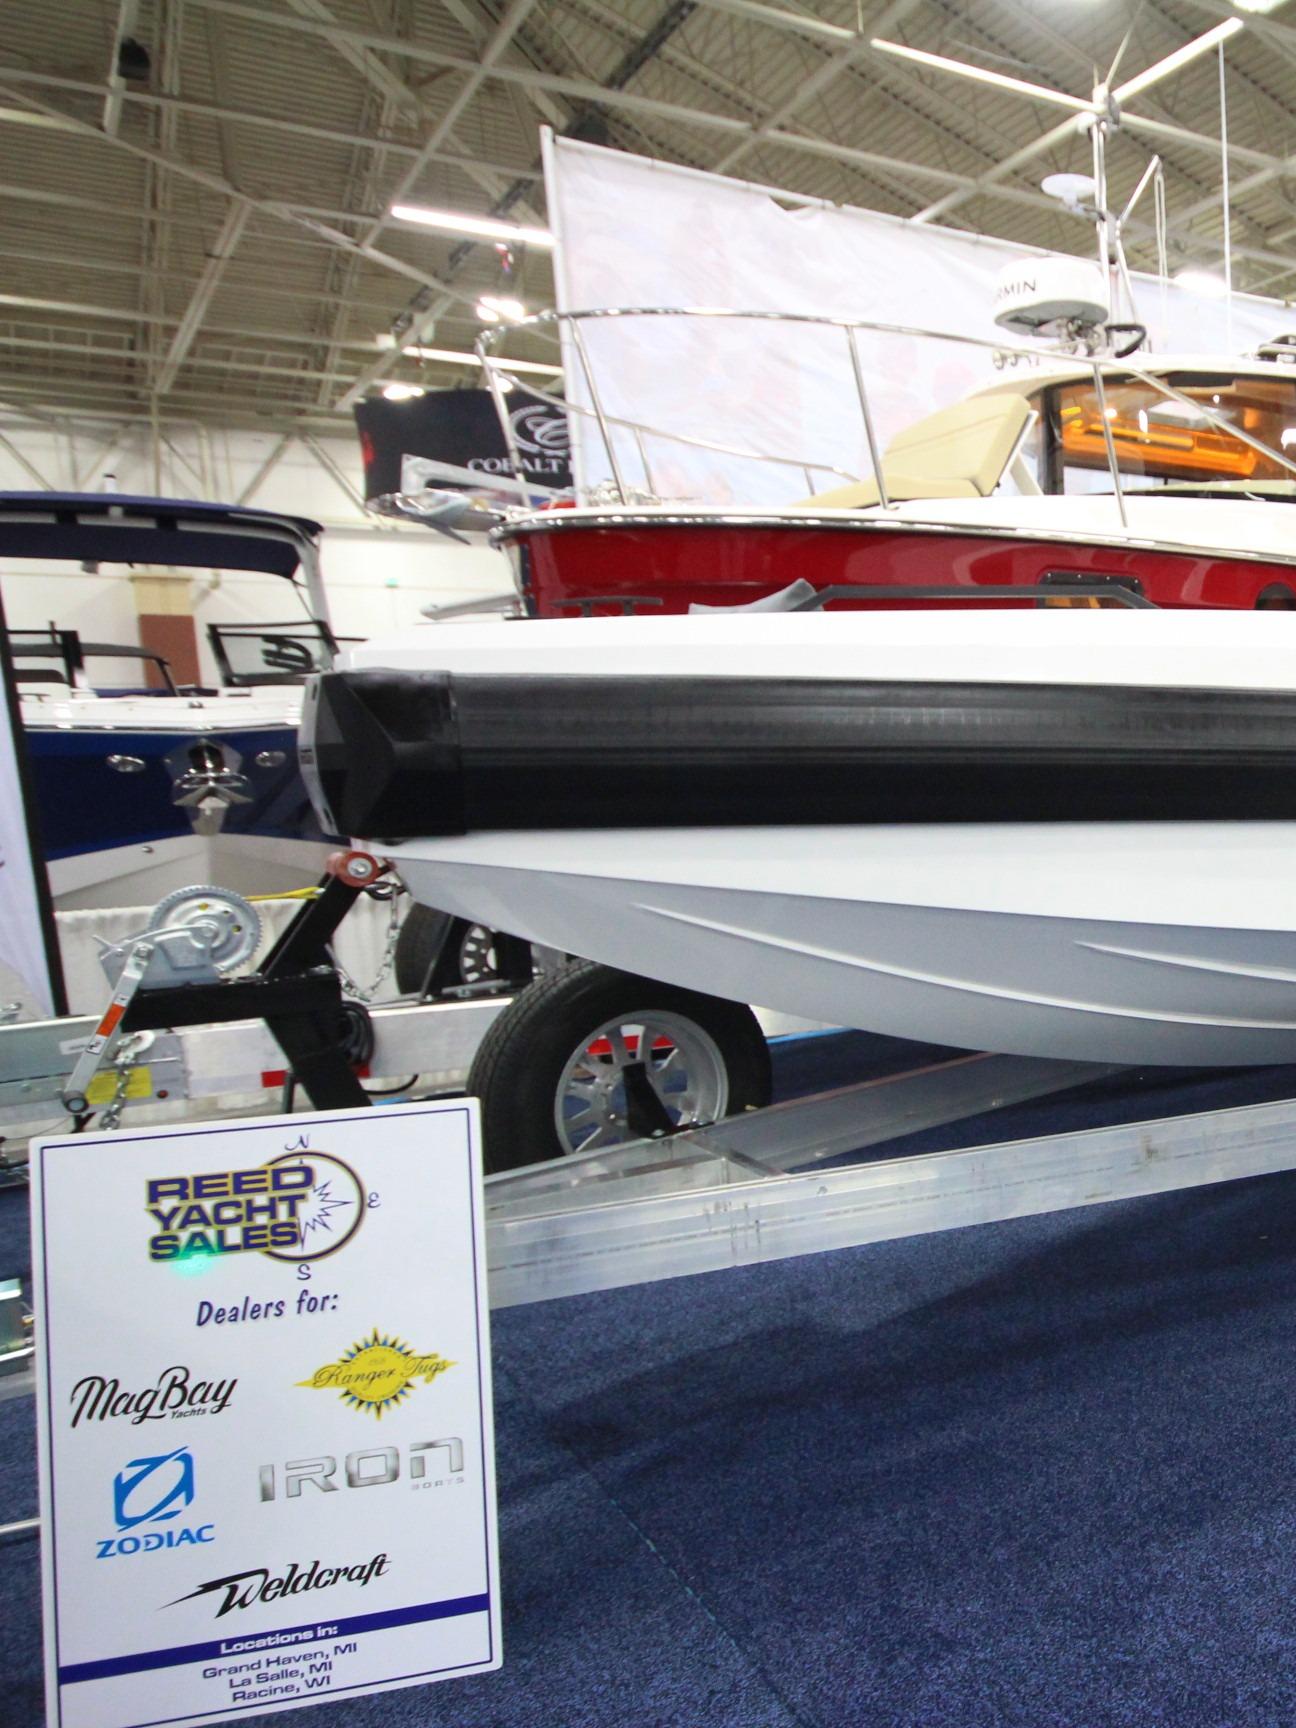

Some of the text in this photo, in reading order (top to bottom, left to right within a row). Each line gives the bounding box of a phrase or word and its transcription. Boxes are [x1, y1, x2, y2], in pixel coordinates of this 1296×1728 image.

[148, 1165, 315, 1204] REED
[149, 1193, 307, 1232] YACHT
[150, 1221, 301, 1261] SALES
[196, 1289, 339, 1327] Dealers for:
[312, 1353, 448, 1391] Ranger Tugs
[70, 1365, 238, 1429] MagBay
[170, 1407, 208, 1420] Yachts
[259, 1436, 465, 1503] IRON
[95, 1525, 216, 1560] ZODIAC
[190, 1553, 392, 1620] Weldcraft
[220, 1625, 339, 1655] Locations in:
[202, 1642, 358, 1680] Grand Haven, MI
[229, 1660, 333, 1689] La Salle, MI
[232, 1675, 331, 1703] Racine, WI
